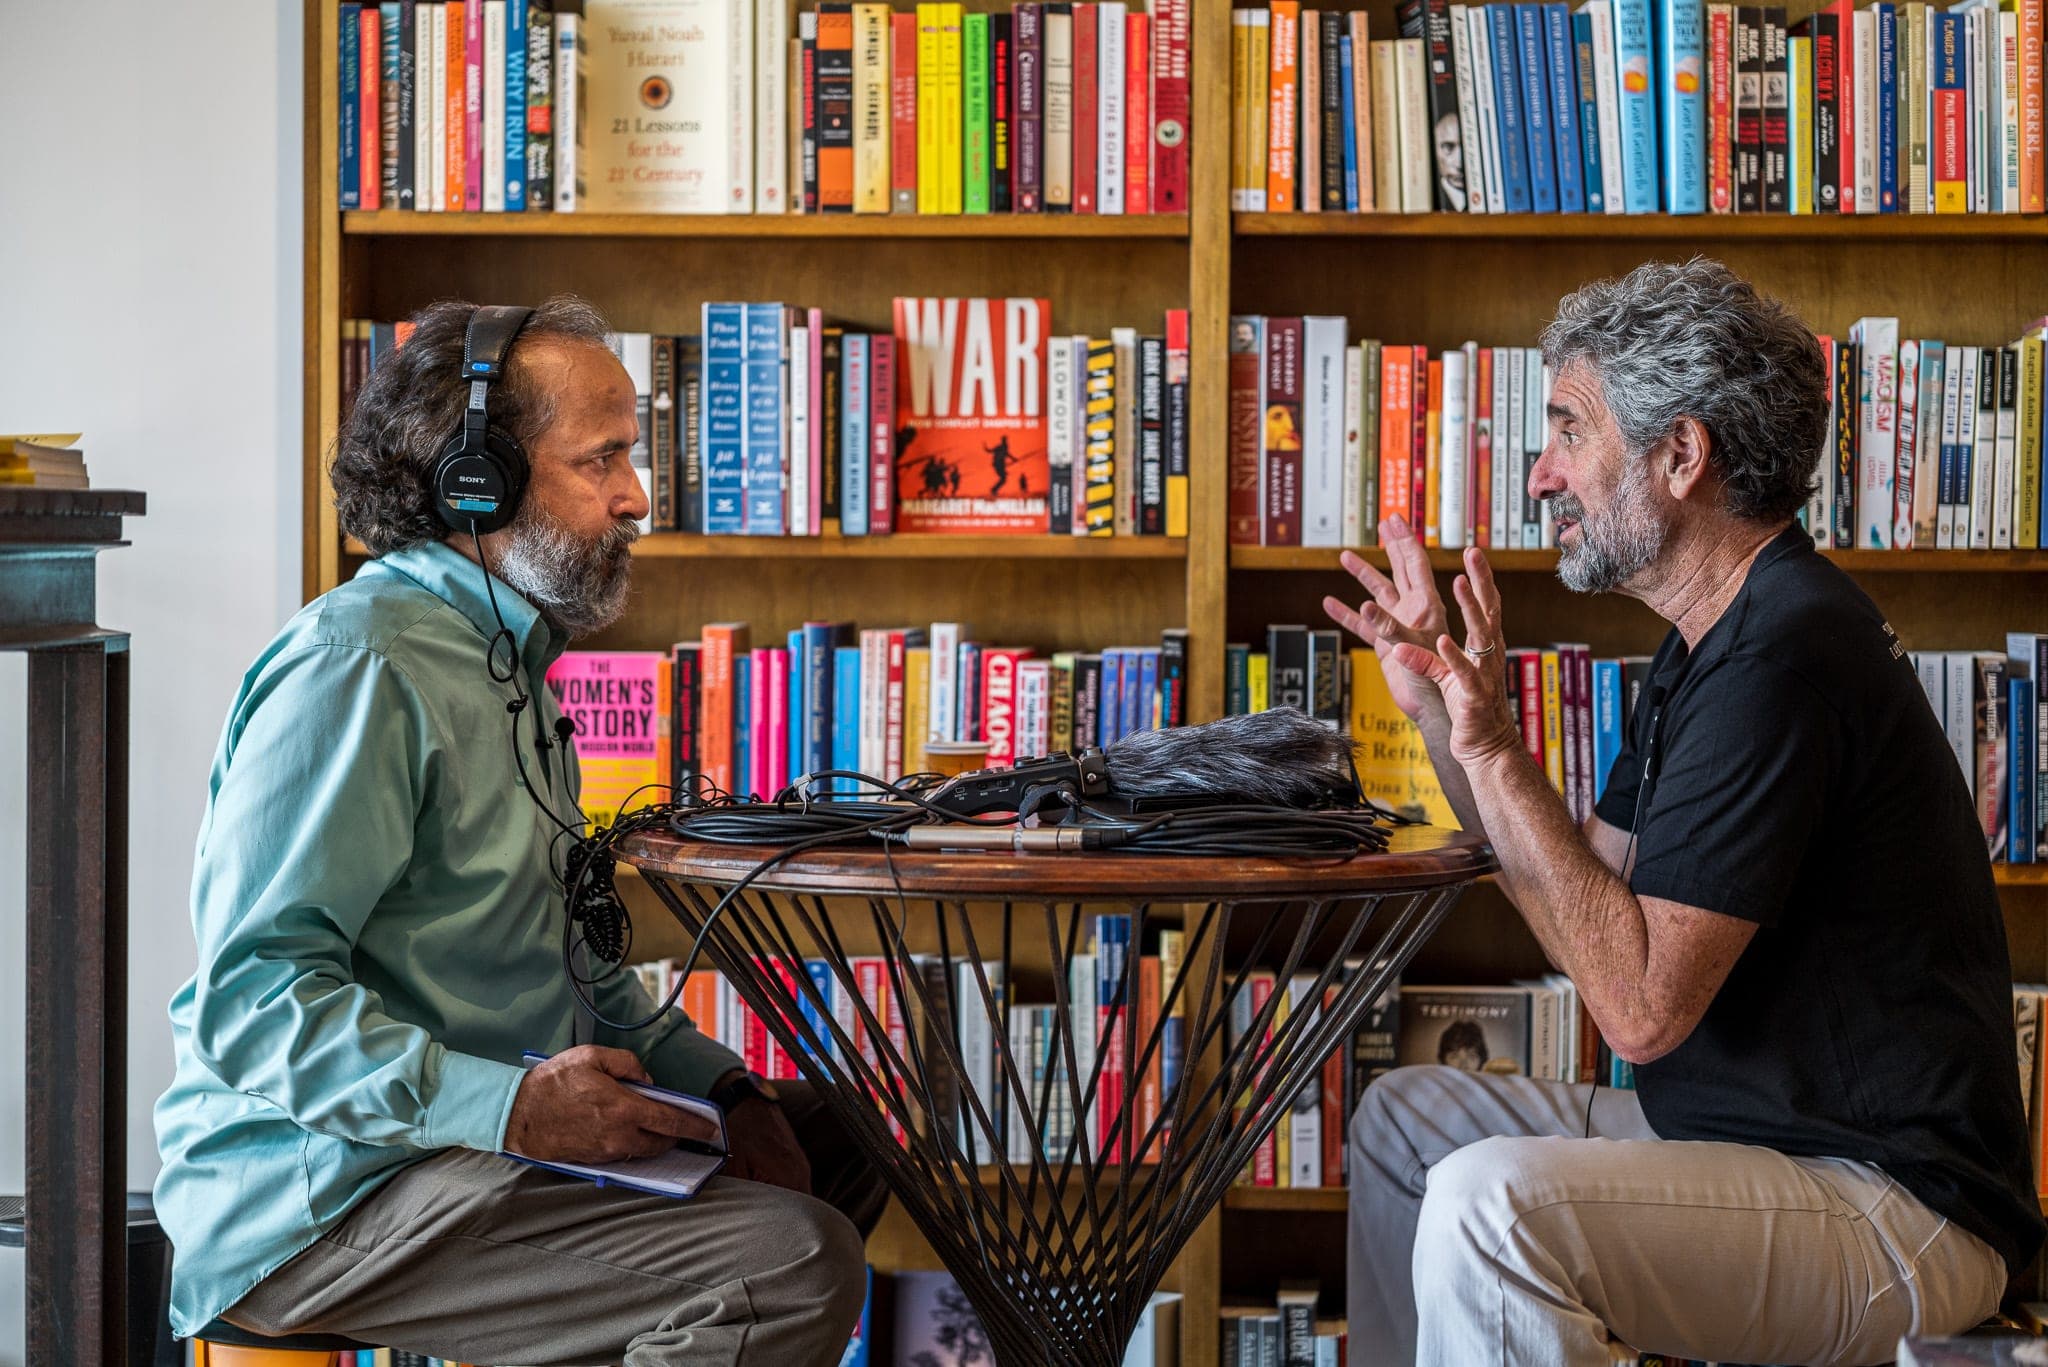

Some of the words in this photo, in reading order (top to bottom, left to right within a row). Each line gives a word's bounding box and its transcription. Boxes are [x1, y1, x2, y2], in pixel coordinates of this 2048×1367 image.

[2026, 0, 2041, 32] IRL
[505, 50, 525, 101] WHY
[2025, 36, 2041, 90] GURL
[505, 115, 525, 161] RUN
[635, 117, 702, 134] Lessons
[2024, 92, 2041, 158] GRRRL
[902, 297, 1040, 418] WAR
[1143, 340, 1161, 375] DARK
[1053, 348, 1068, 441] BLOWOUT
[1143, 376, 1161, 421] MONEY
[1239, 388, 1257, 491] EINSTEIN
[458, 475, 486, 484] SONY
[902, 498, 970, 515] MARGARET
[590, 660, 610, 674] THE
[550, 679, 655, 706] WOMEN'S
[985, 654, 1014, 758] CHAOS
[567, 709, 652, 737] STORY
[1421, 1004, 1511, 1019] TESTIMONY
